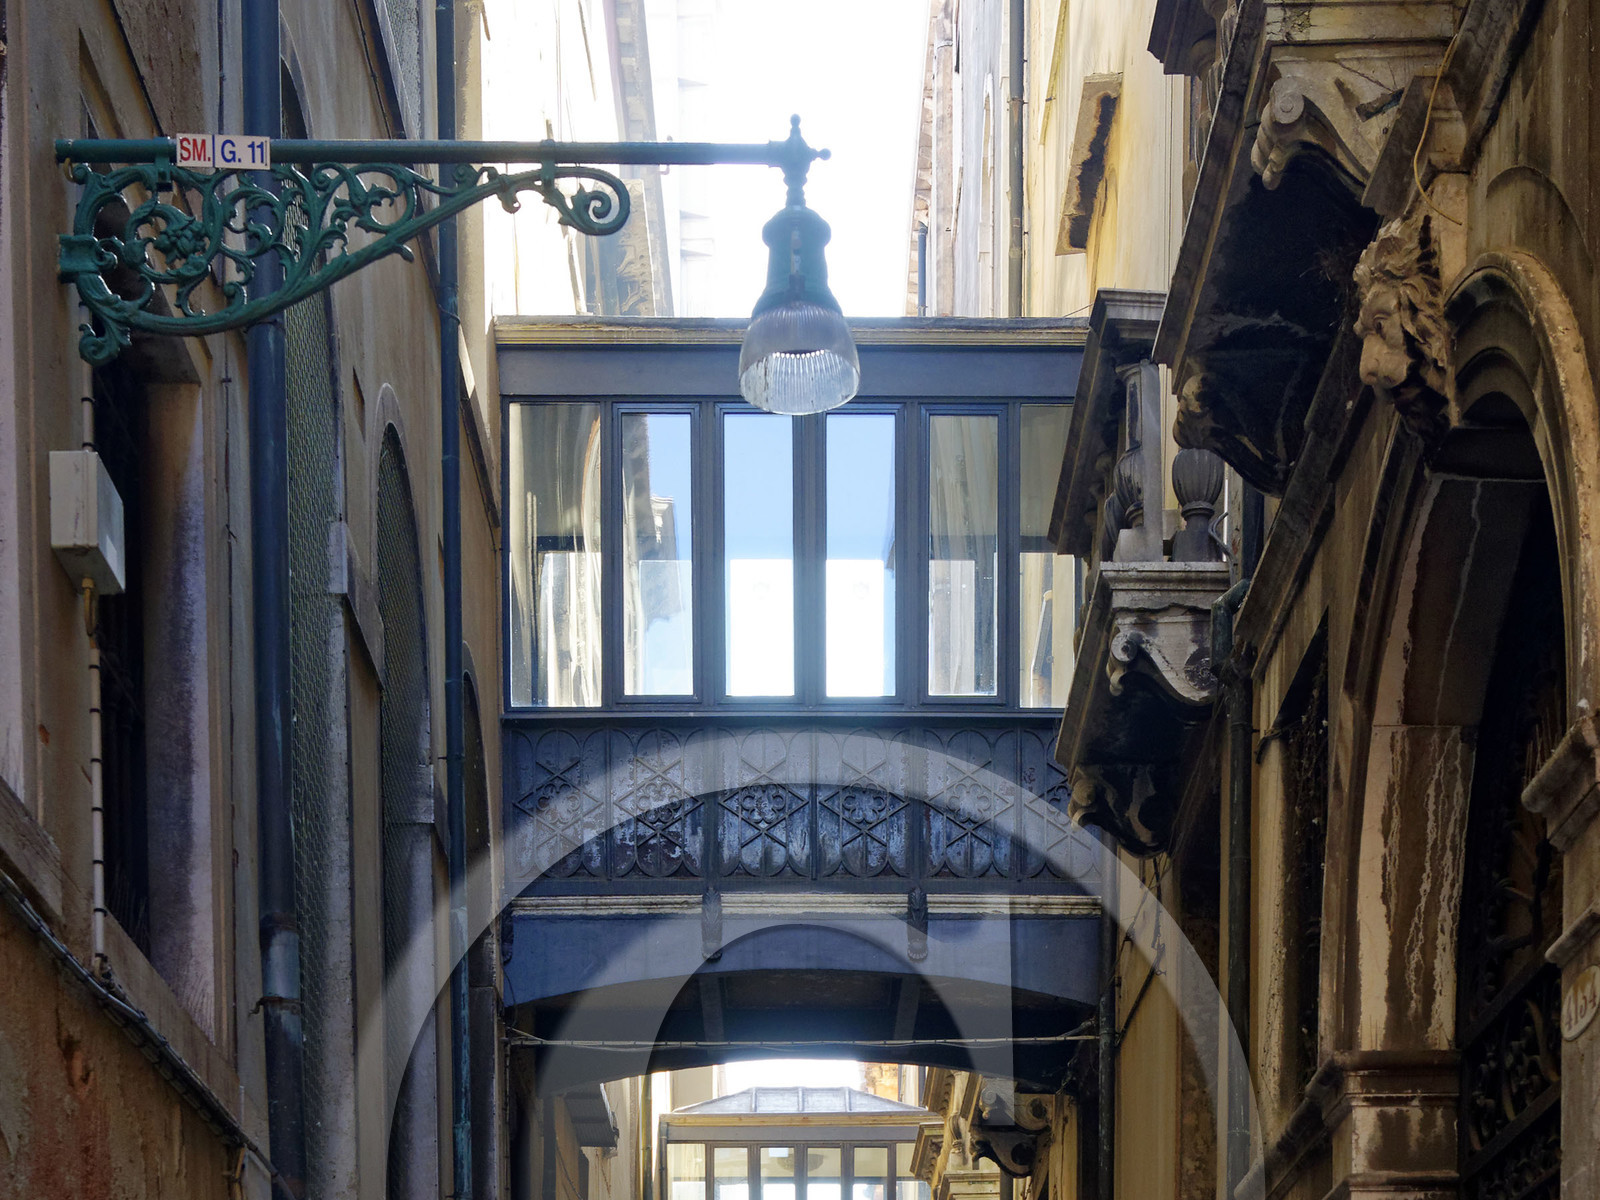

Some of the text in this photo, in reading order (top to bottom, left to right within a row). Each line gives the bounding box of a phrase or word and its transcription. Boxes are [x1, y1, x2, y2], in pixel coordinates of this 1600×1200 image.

[180, 137, 265, 164] SM. G. 11
